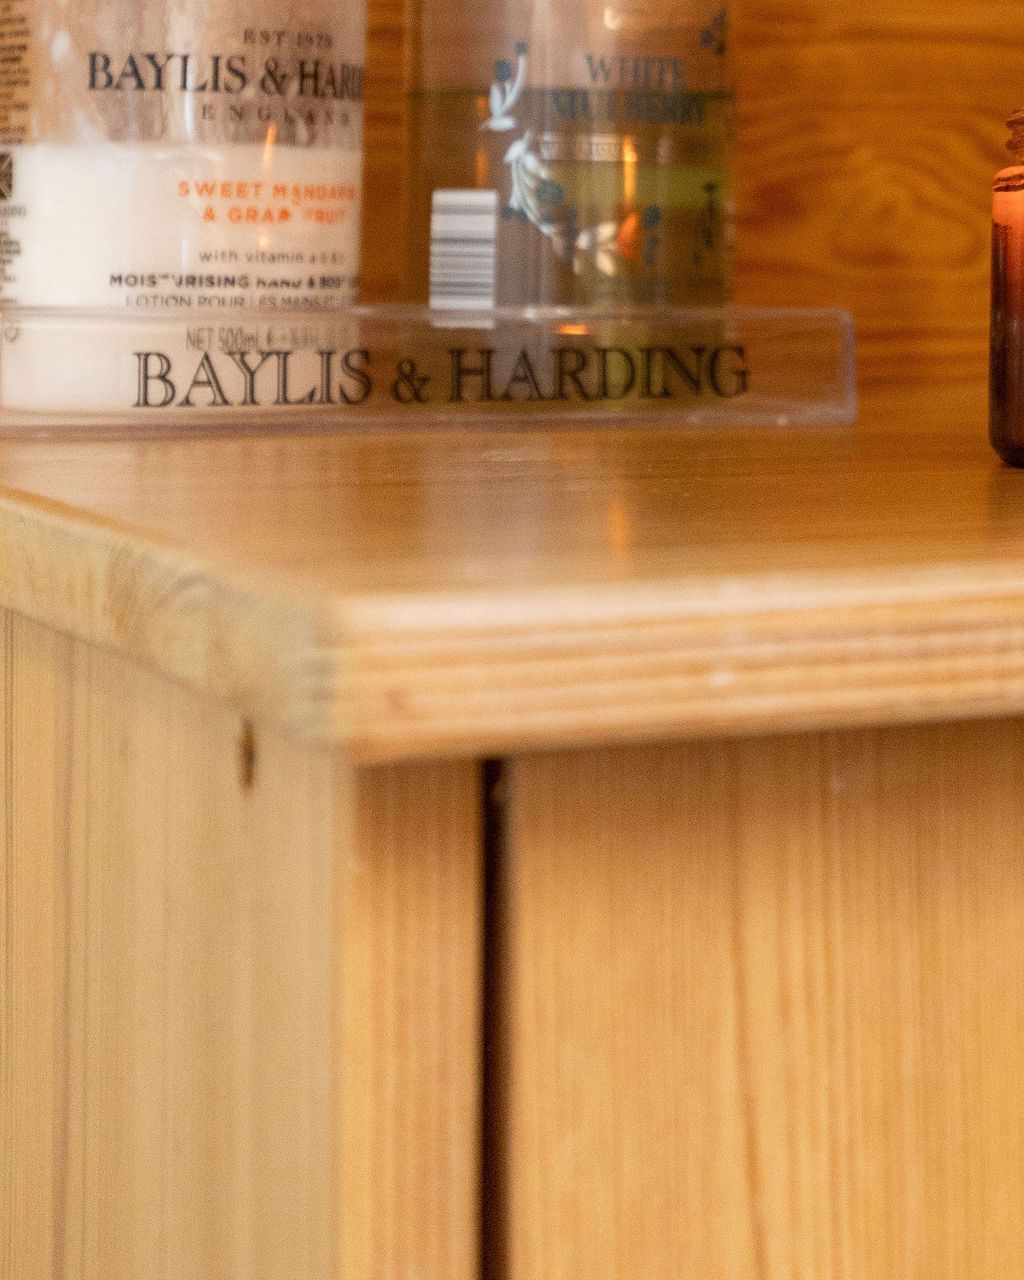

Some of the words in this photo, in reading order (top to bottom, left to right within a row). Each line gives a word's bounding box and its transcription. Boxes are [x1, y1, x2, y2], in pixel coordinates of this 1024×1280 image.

[87, 51, 250, 94] BAYLIS
[259, 56, 288, 97] &
[178, 180, 263, 198] SWEET
[199, 250, 239, 263] with
[132, 348, 373, 408] BAYLIS
[390, 356, 430, 405] &
[447, 345, 750, 402] HARDING
